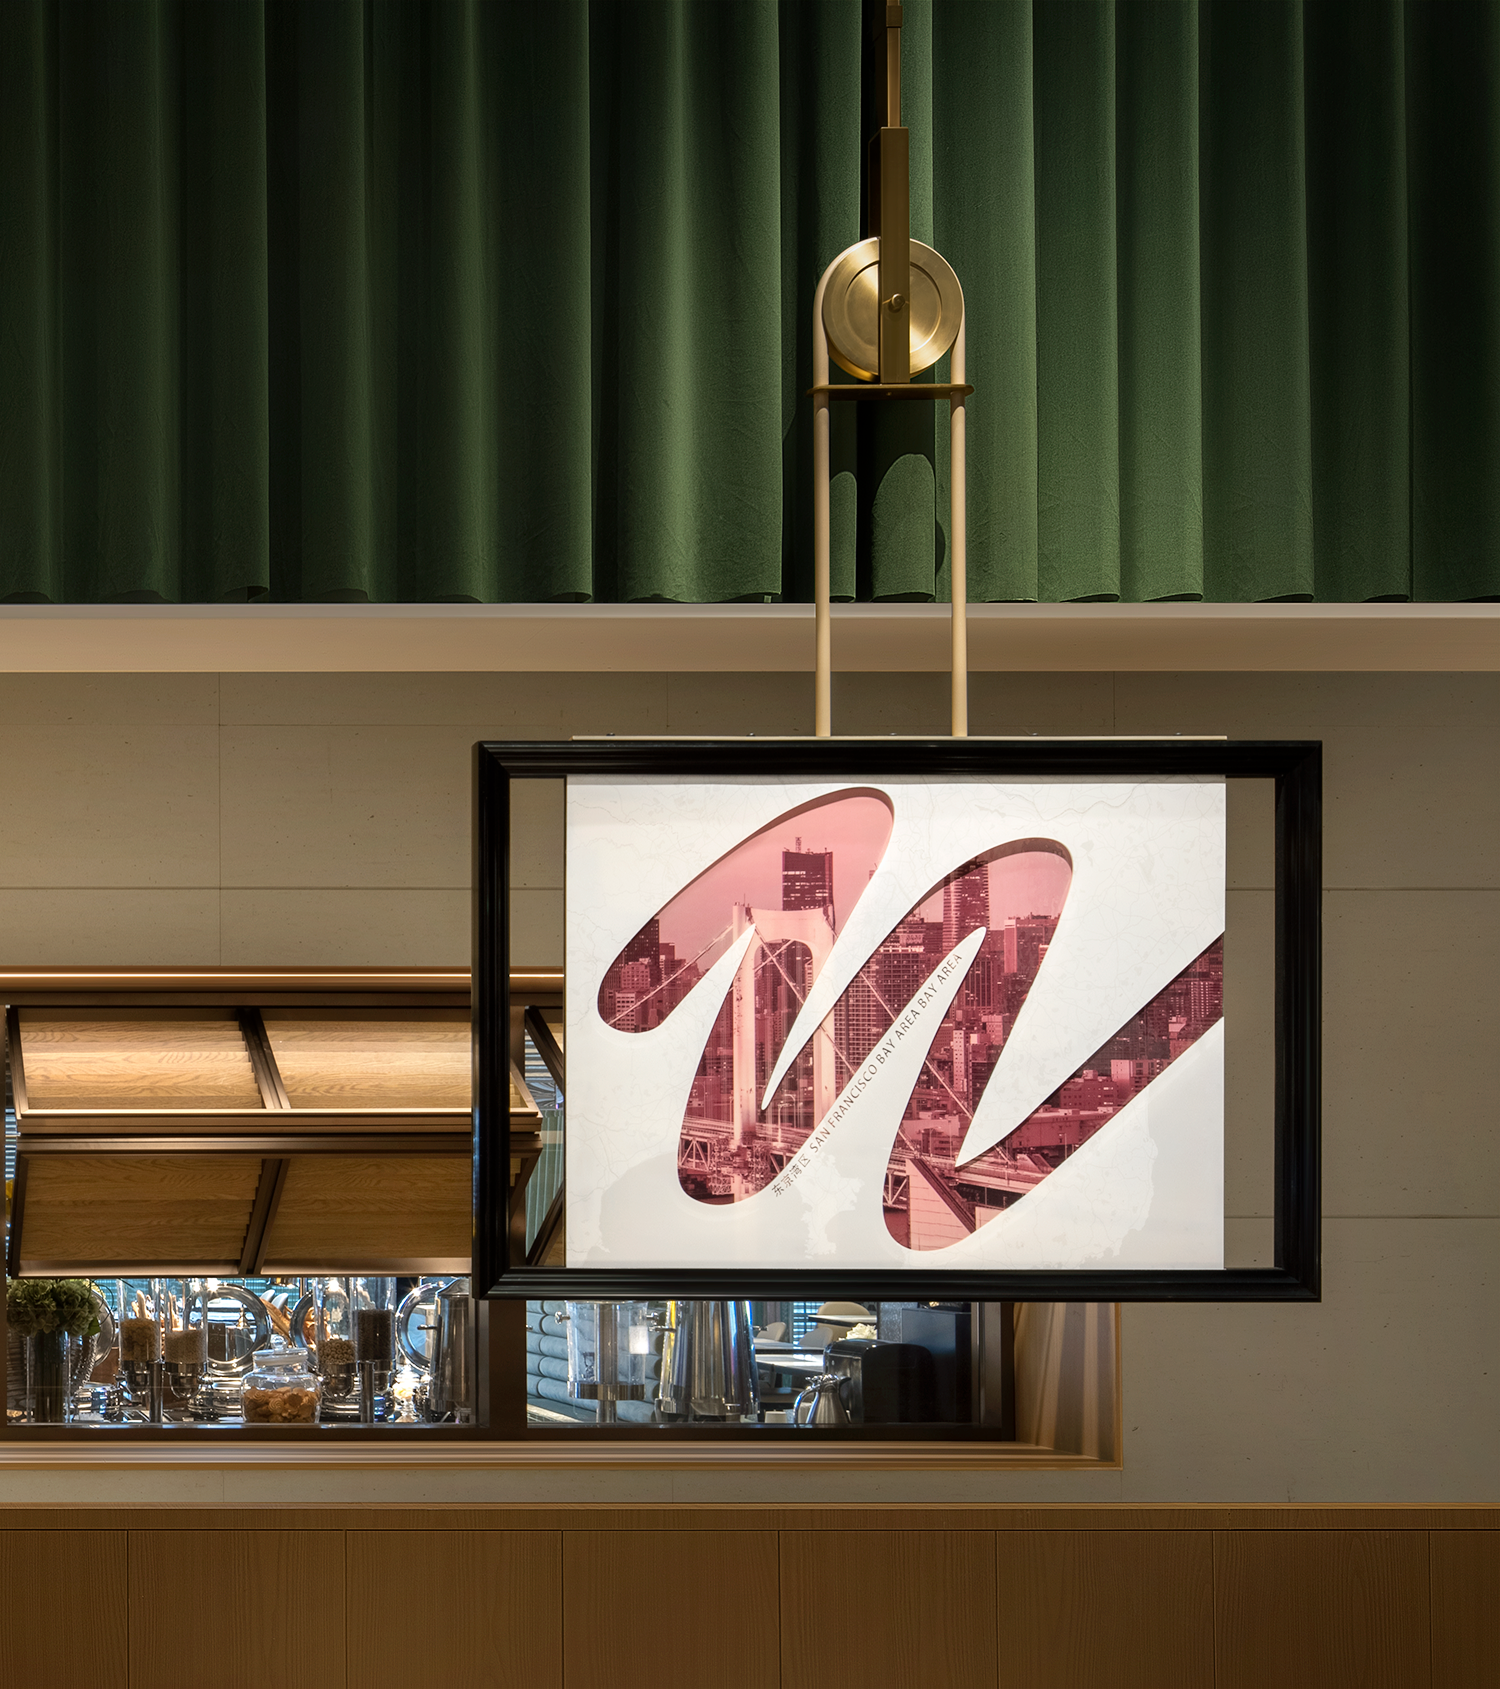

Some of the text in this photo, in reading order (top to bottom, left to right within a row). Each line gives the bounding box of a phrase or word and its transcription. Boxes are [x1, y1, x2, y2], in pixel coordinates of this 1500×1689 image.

[809, 953, 963, 1153] SAN FRANCISCO BAY AREA BAY AREA
[771, 1153, 811, 1197] 东京湾区
